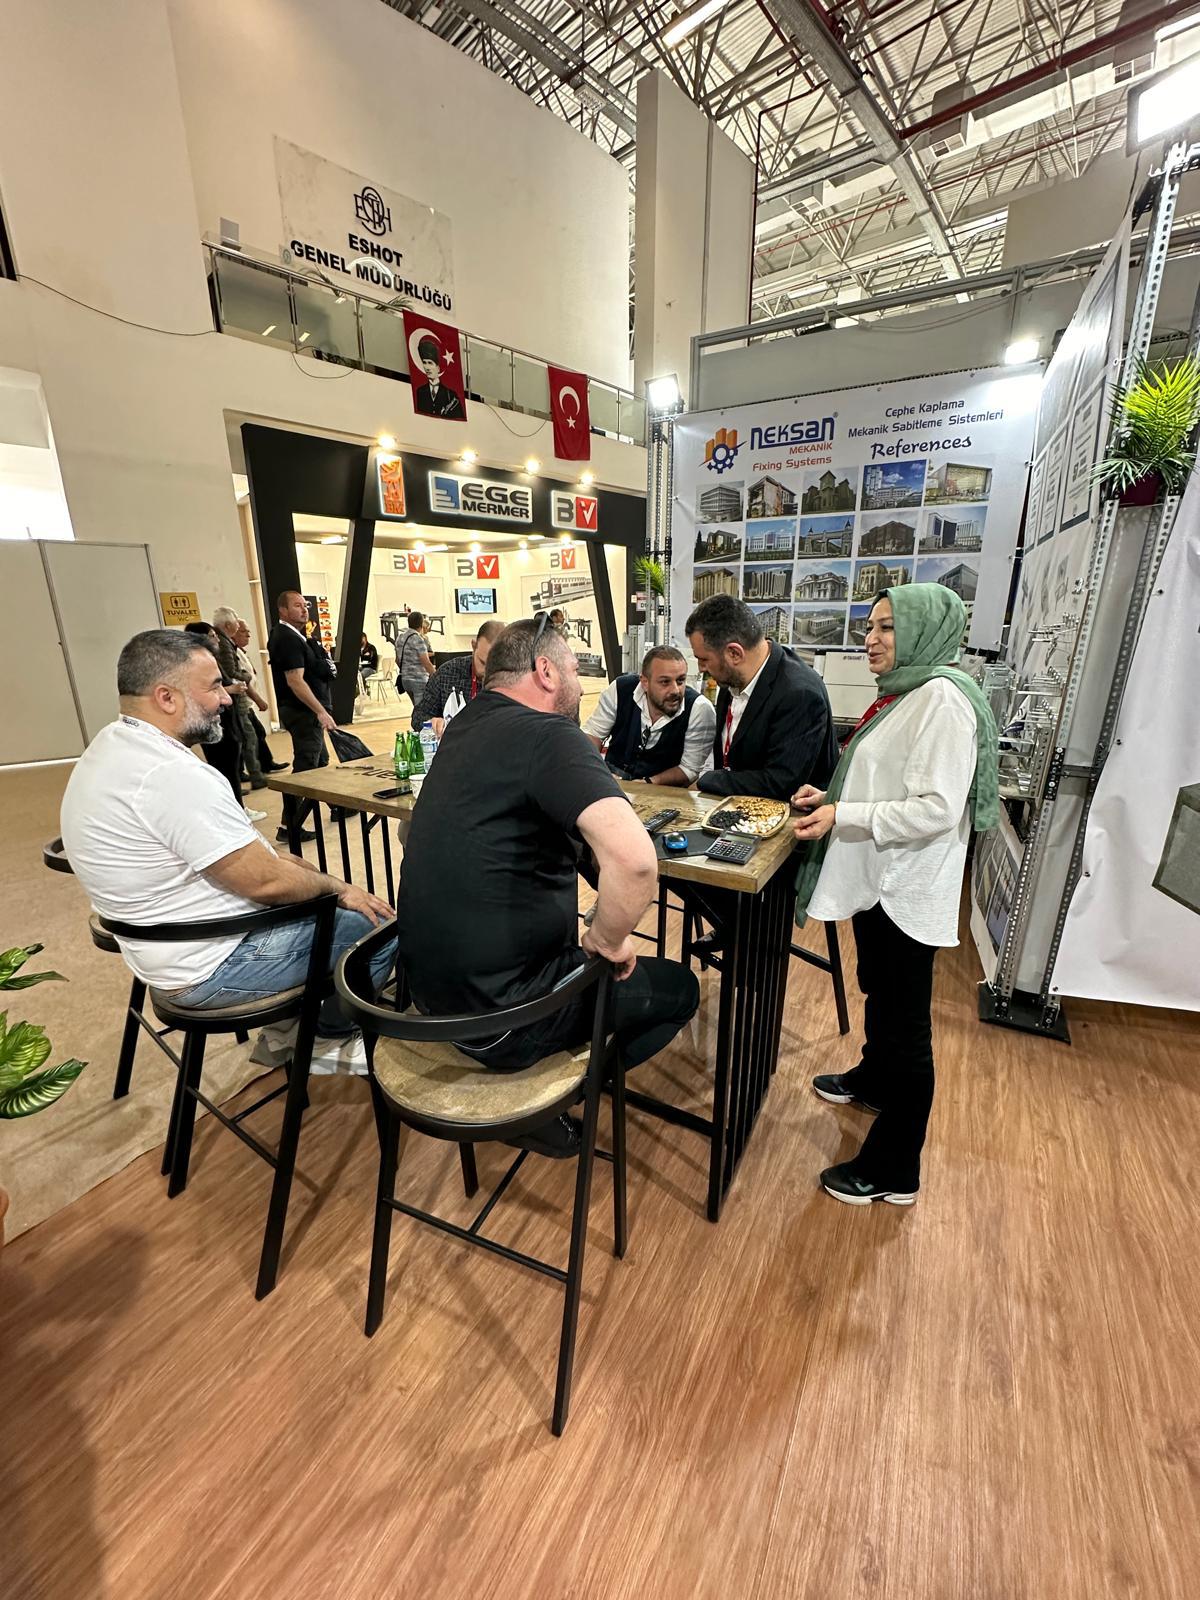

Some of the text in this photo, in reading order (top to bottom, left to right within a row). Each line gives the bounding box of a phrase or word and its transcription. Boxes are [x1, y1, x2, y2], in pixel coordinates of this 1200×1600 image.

[348, 233, 403, 267] ESHOT
[290, 240, 452, 311] GENEL MÜDÜRLÜĞÜ
[885, 400, 965, 418] Cephe Kaplama
[848, 409, 1004, 438] Mekanik Sabitleme Sistemleri
[870, 436, 972, 460] References
[752, 456, 832, 472] Fixing Systems
[461, 482, 529, 508] EGE
[462, 501, 530, 519] MERMER
